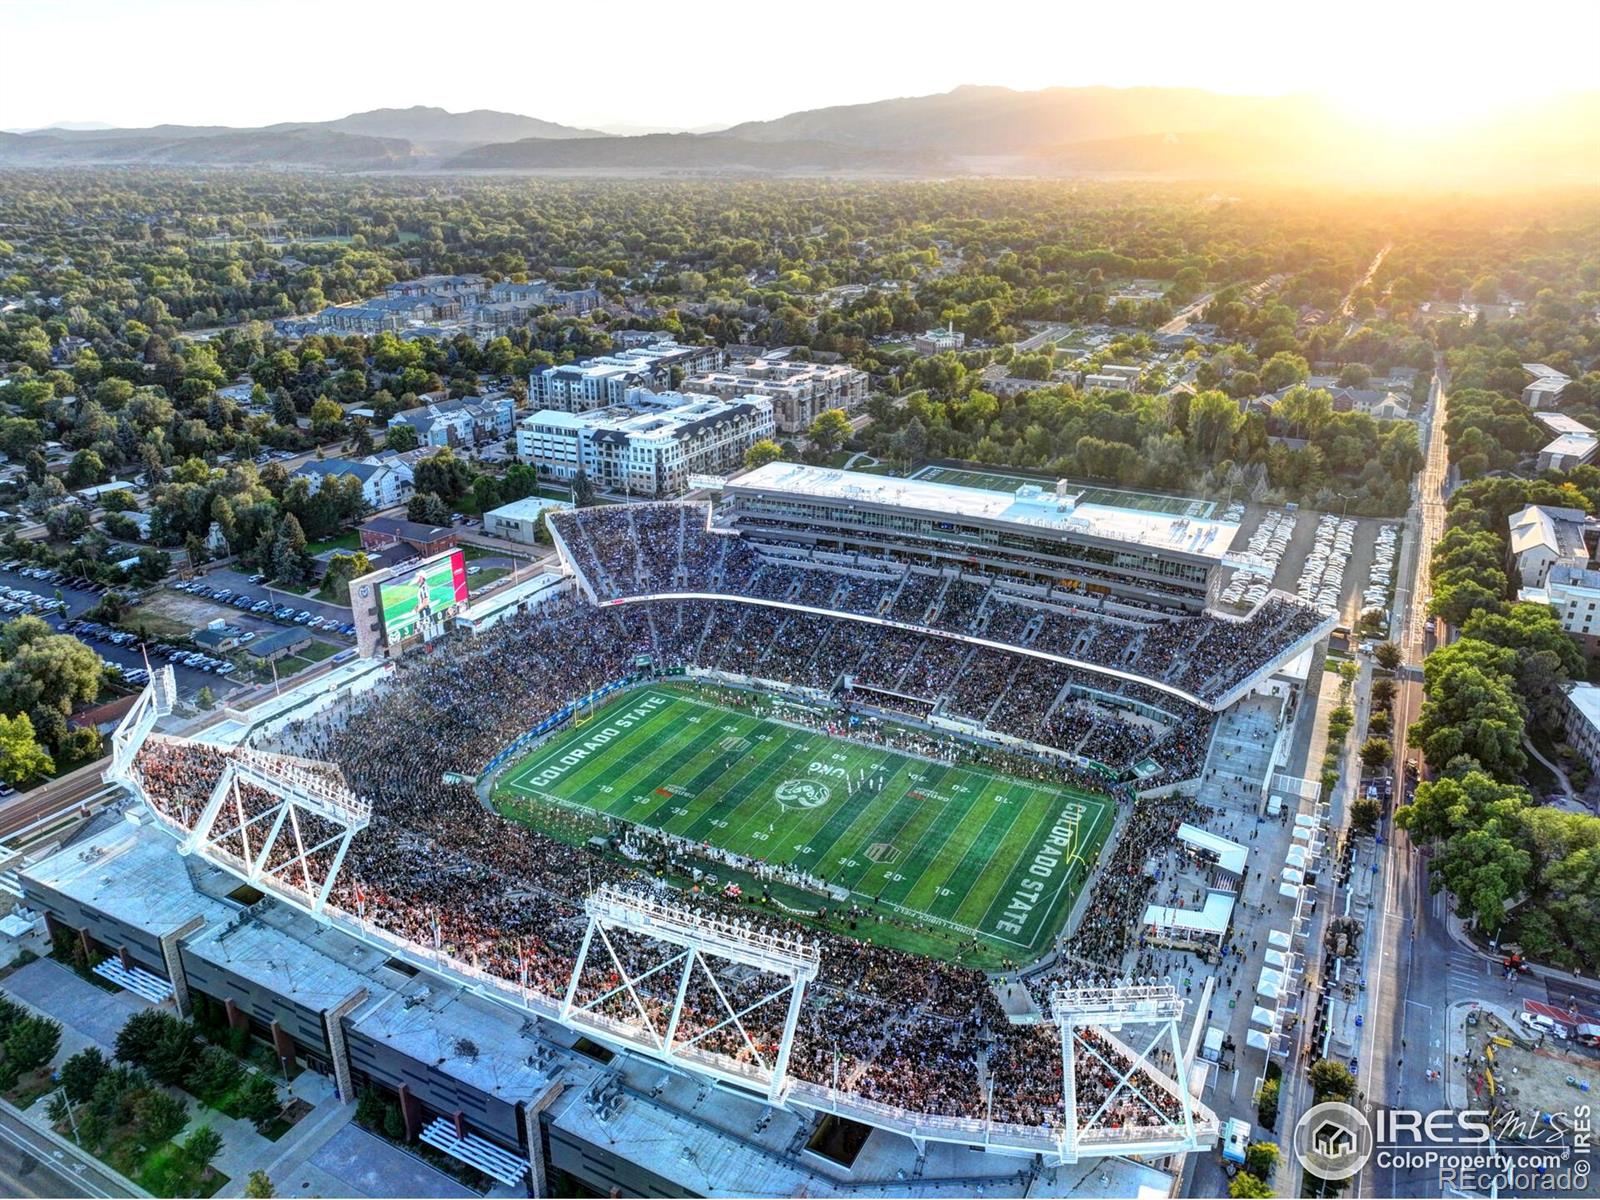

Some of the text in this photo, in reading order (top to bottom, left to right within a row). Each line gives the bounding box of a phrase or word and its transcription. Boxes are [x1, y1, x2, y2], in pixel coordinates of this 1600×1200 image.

[530, 727, 620, 787] COLORADO
[615, 696, 666, 728] STATE
[673, 807, 688, 816] 30
[712, 819, 728, 828] 40
[752, 831, 769, 841] 50
[793, 845, 811, 854] 40
[838, 858, 856, 867] 30
[996, 802, 1087, 936] COLORADO STATE
[883, 871, 902, 882] 20
[935, 887, 951, 896] 10
